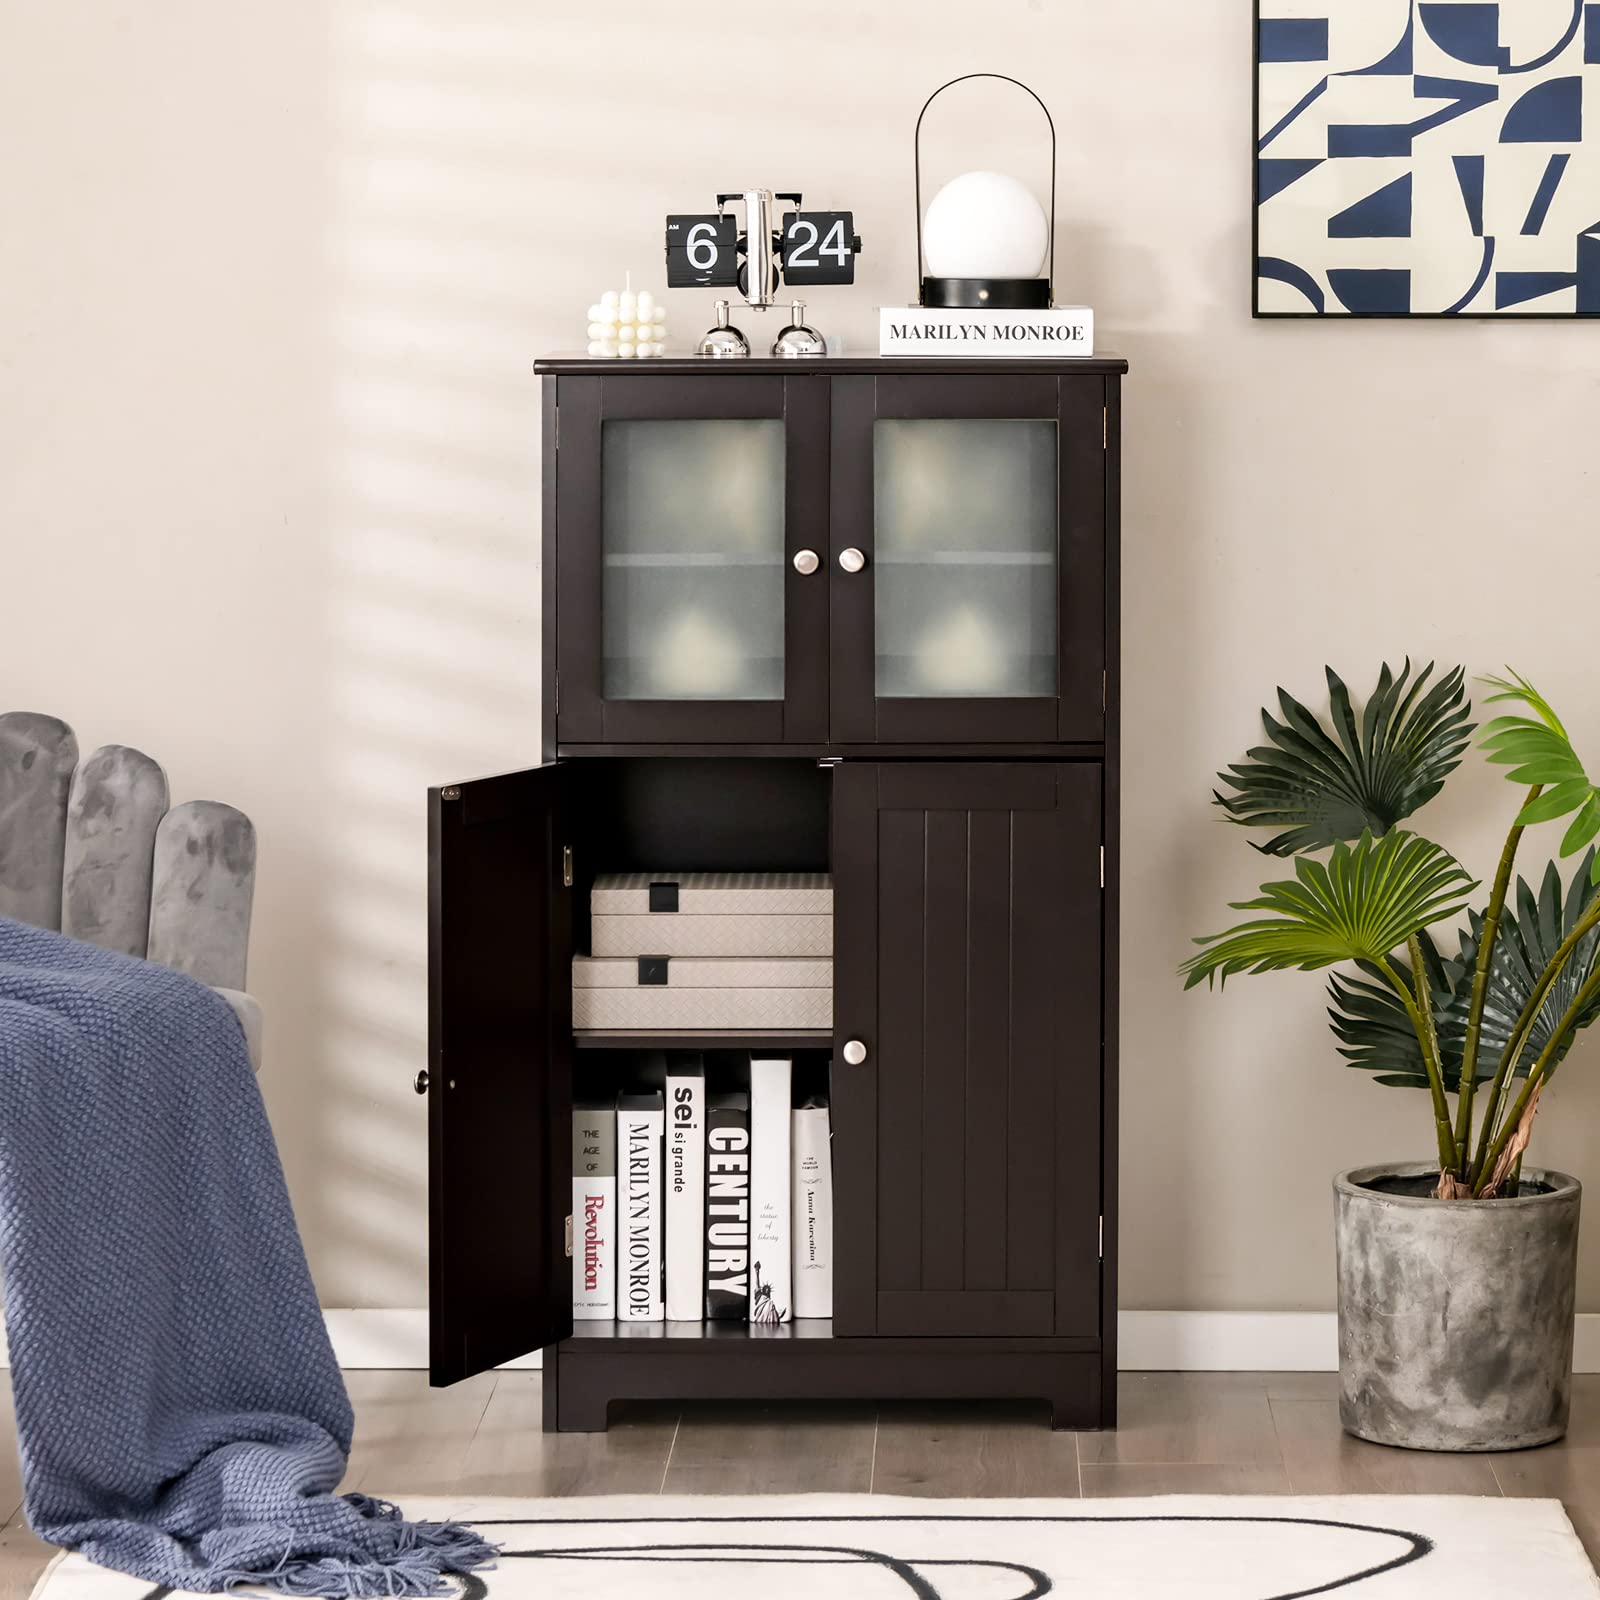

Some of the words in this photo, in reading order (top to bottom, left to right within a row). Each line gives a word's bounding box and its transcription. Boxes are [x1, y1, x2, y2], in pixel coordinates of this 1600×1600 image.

[686, 222, 718, 270] 6
[787, 219, 852, 268] 24
[889, 324, 987, 341] MARILYN
[992, 324, 1085, 342] MONROE
[673, 1087, 698, 1129] sei
[581, 1129, 600, 1138] THE
[582, 1146, 600, 1155] AGE
[673, 1132, 686, 1144] si
[585, 1162, 599, 1171] OF
[629, 1123, 650, 1220] MARILYN
[671, 1147, 686, 1193] grande
[708, 1126, 749, 1297] CENTURY
[807, 1188, 815, 1214] Anna
[584, 1194, 605, 1291] Revolution
[808, 1217, 817, 1261] Karenina
[629, 1225, 650, 1316] MONROE
